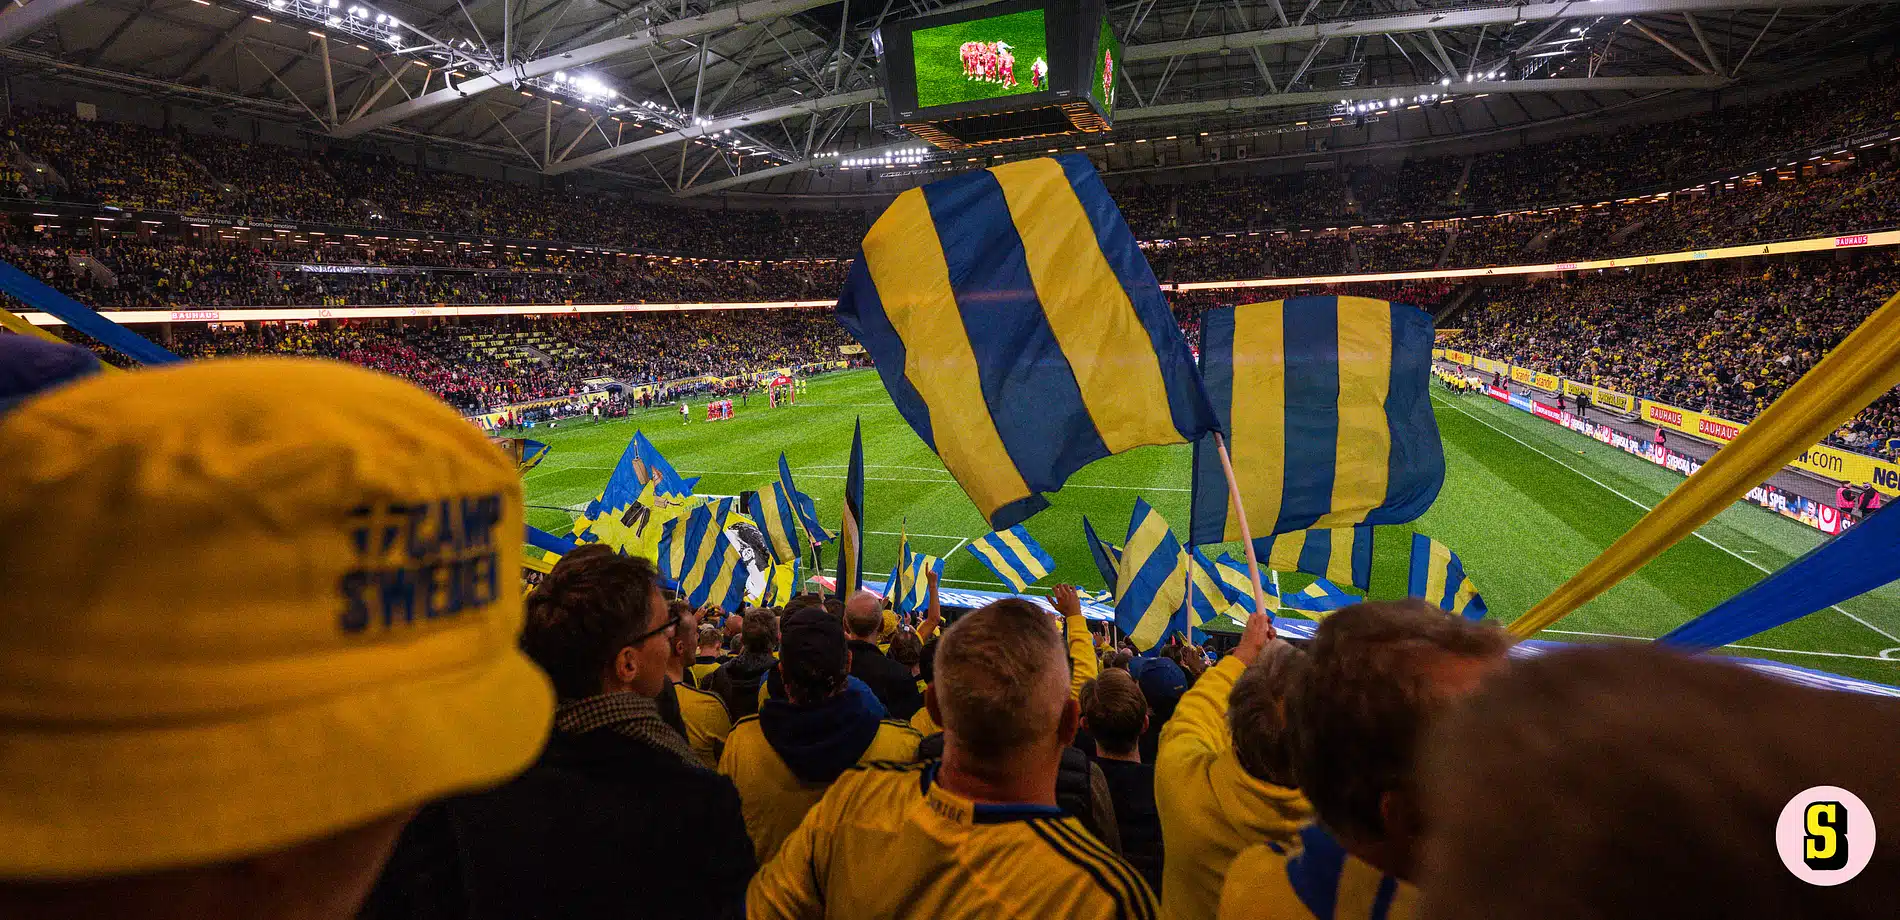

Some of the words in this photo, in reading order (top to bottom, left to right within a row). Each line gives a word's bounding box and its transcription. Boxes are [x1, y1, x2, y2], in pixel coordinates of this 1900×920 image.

[180, 215, 213, 225] Strawberry
[273, 222, 298, 230] emotions
[1835, 235, 1867, 246] BAUHAUS
[172, 311, 219, 321] BAUHAUS
[1650, 406, 1682, 425] BAUHAUS
[1667, 453, 1690, 474] SVENSKA
[1873, 466, 1900, 491] Ne
[1769, 491, 1786, 510] SPEL
[407, 493, 502, 556] CAMP
[338, 551, 499, 634] SWEDEN
